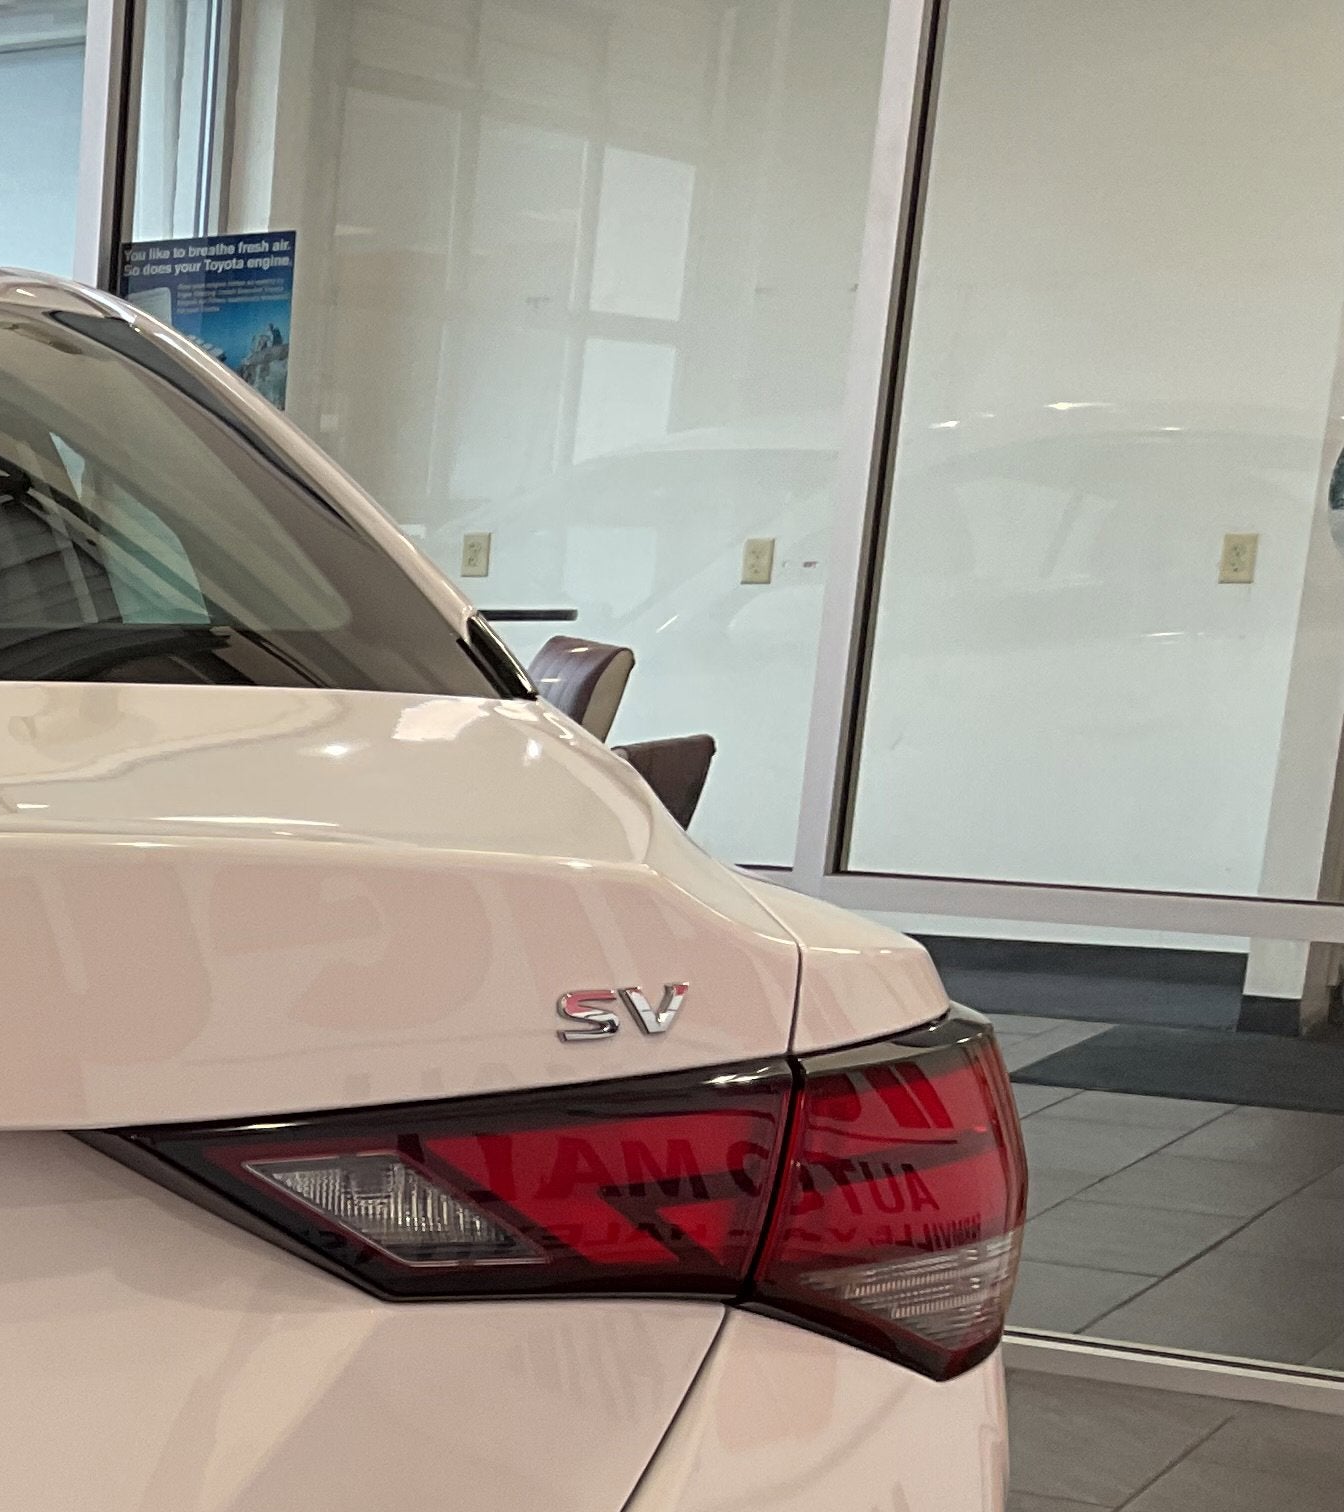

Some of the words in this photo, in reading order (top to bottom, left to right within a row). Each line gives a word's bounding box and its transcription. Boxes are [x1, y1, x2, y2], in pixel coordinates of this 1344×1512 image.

[124, 249, 145, 262] You
[149, 247, 170, 259] like
[173, 247, 186, 258] to
[188, 243, 235, 258] breathe
[238, 241, 269, 254] fresh
[124, 265, 140, 277] So
[143, 263, 172, 275] does
[174, 262, 201, 275] your
[204, 258, 244, 274] Toyota
[556, 981, 690, 1044] SV
